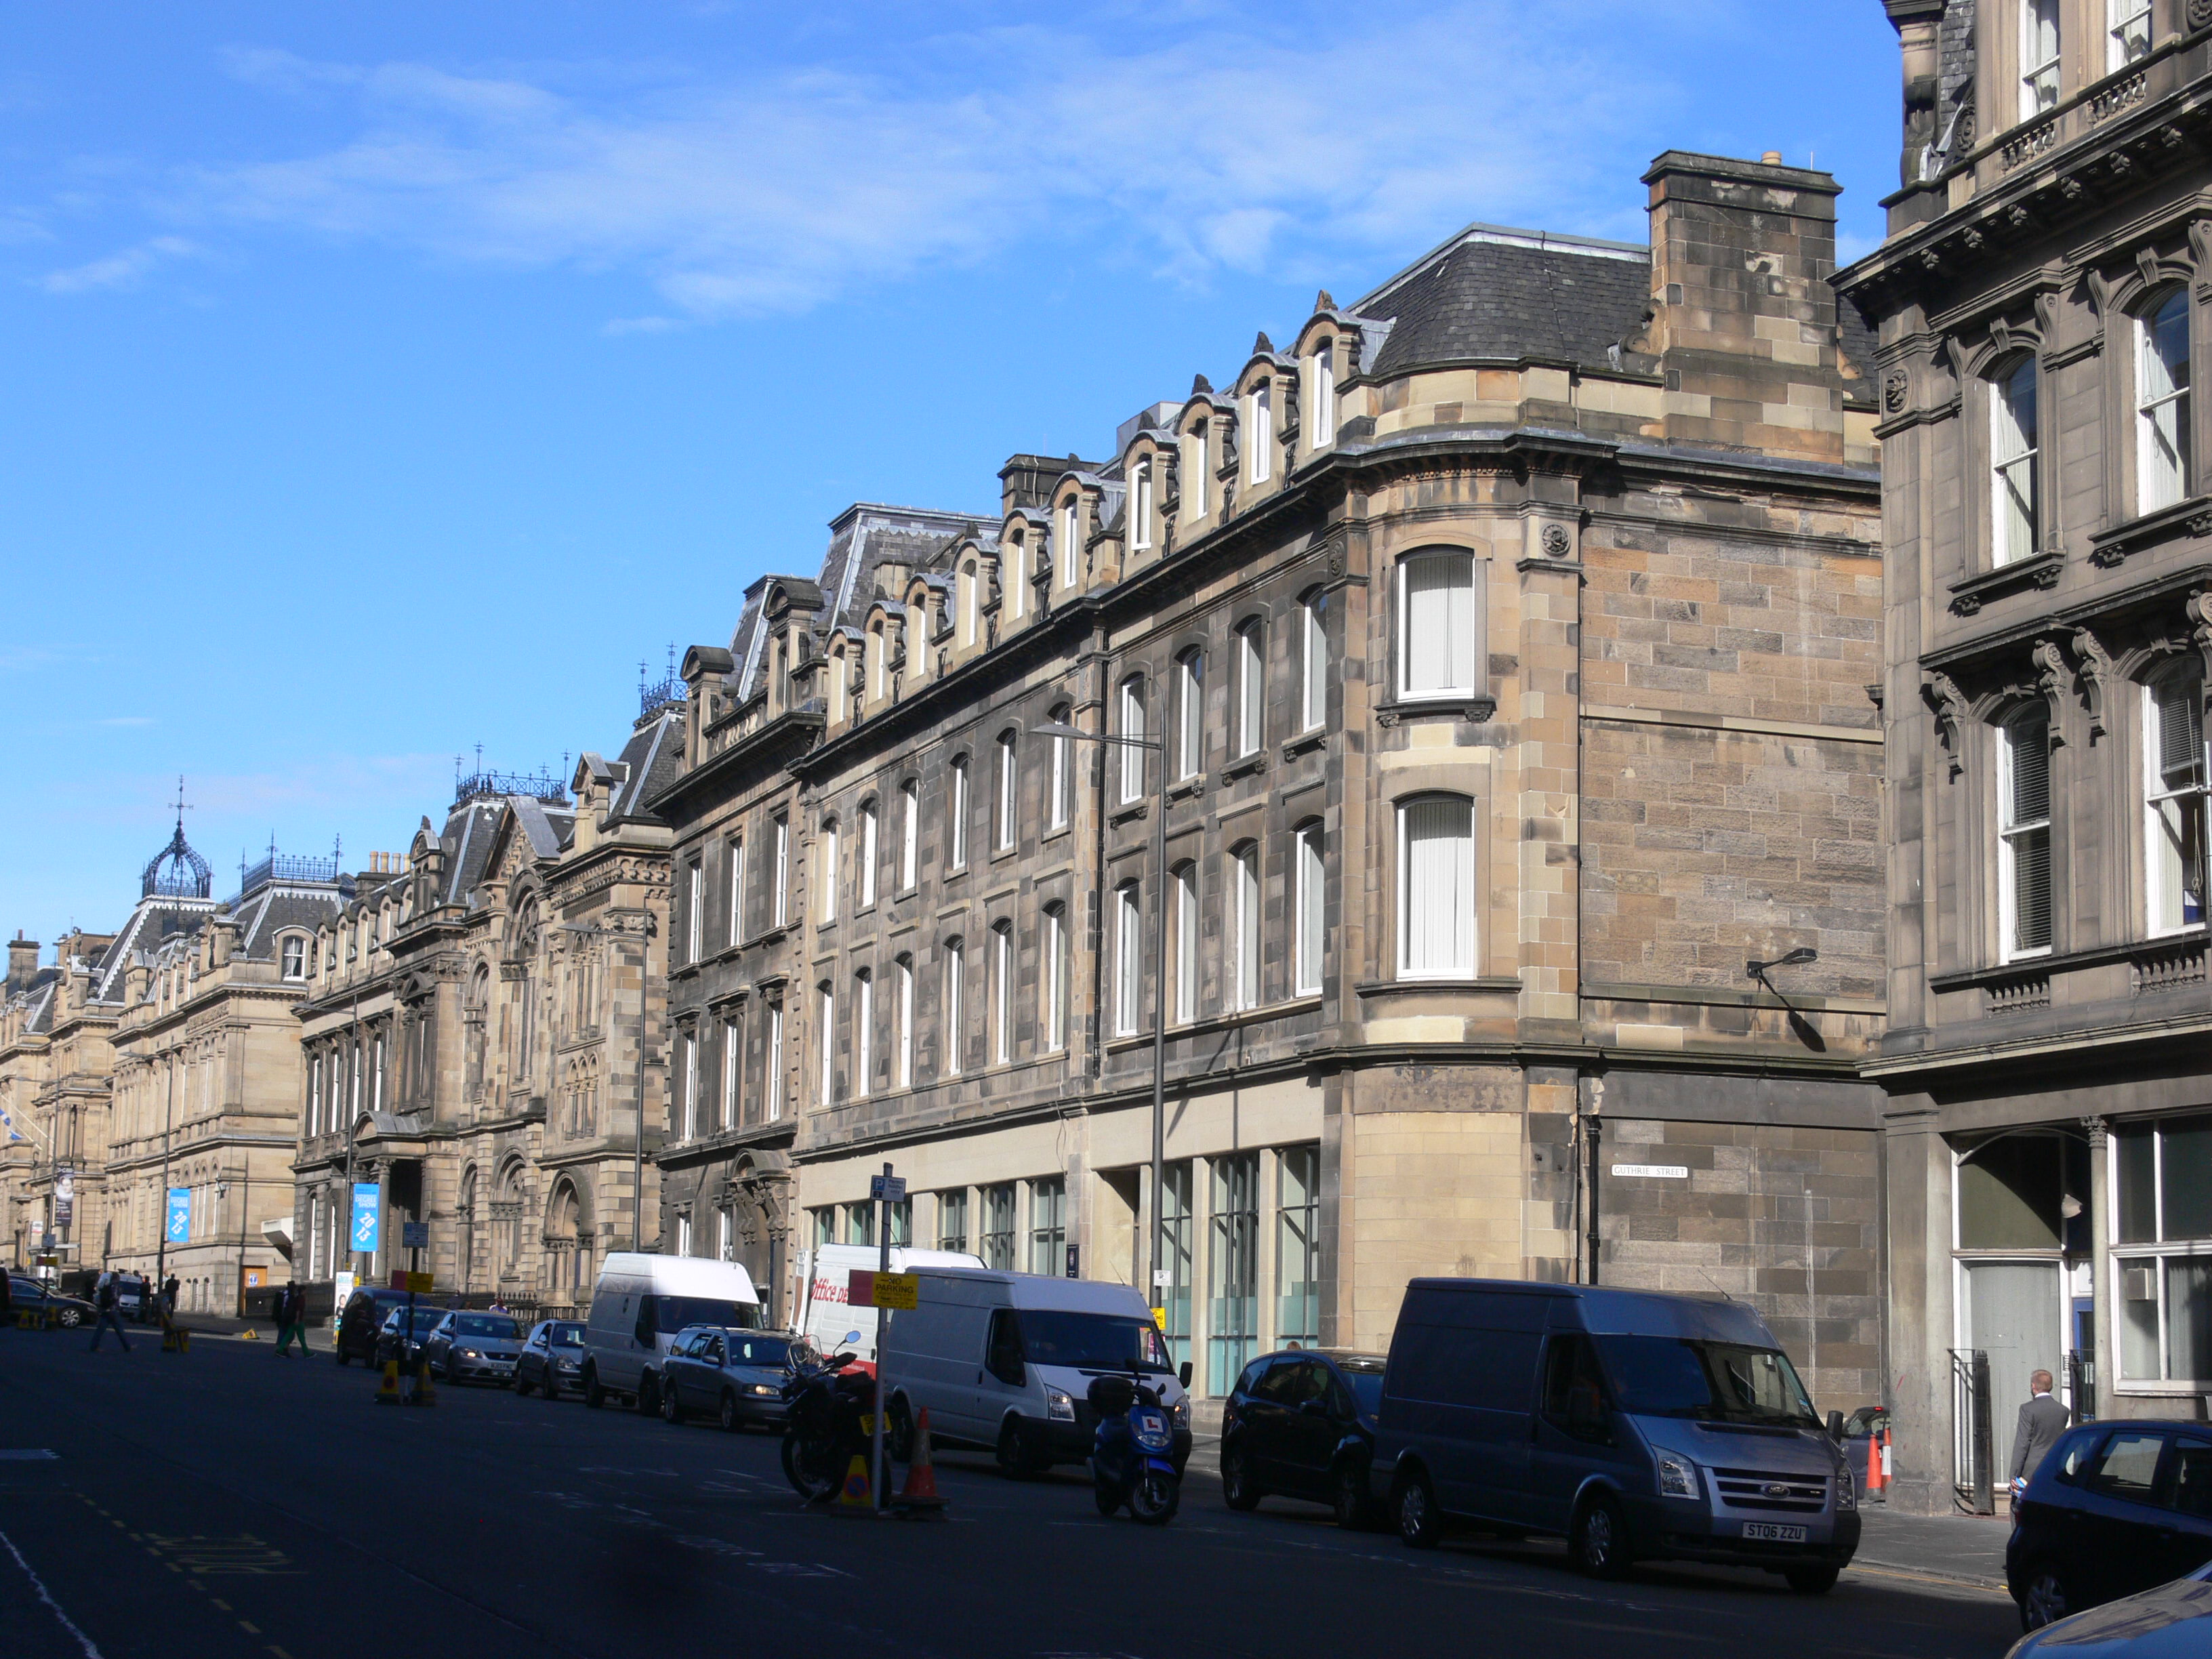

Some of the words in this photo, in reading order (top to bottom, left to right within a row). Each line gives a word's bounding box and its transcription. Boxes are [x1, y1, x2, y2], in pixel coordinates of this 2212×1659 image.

[1614, 1166, 1650, 1174] GUTHRIE
[1656, 1168, 1685, 1176] STREET
[875, 1179, 884, 1189] P
[811, 1277, 838, 1301] Office
[876, 1284, 914, 1294] PARKING
[1147, 1418, 1158, 1428] L
[1748, 1523, 1777, 1538] ST06
[1780, 1526, 1801, 1539] ZZU
